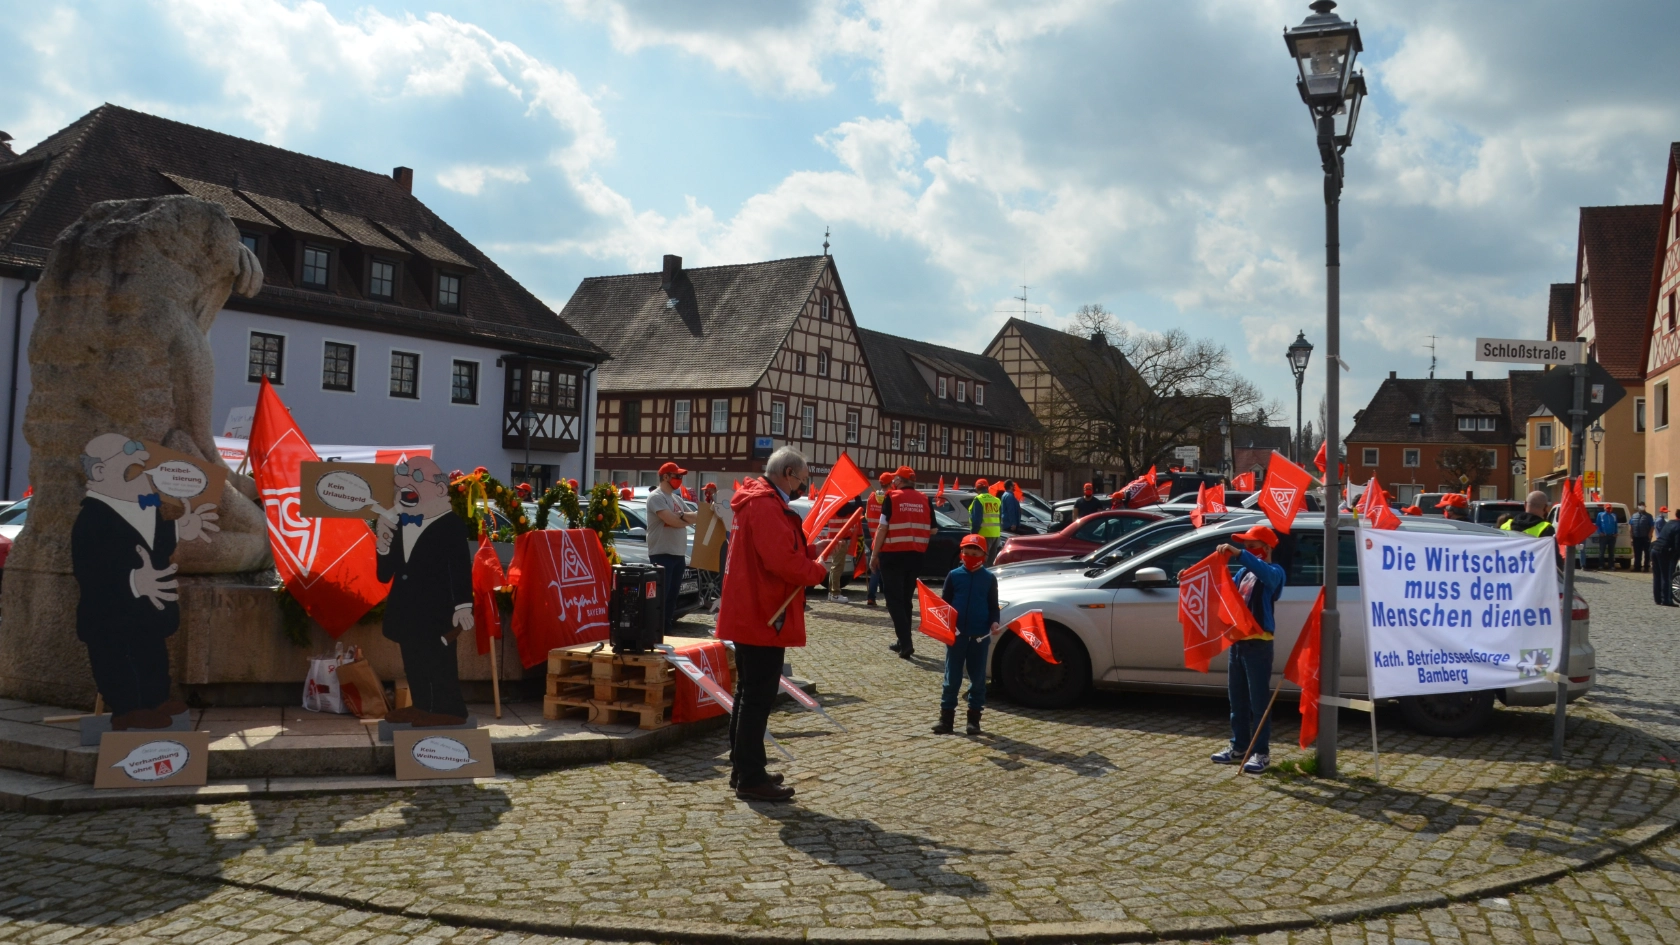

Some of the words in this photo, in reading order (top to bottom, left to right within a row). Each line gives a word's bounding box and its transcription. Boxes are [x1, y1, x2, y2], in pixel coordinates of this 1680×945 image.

[1483, 342, 1566, 360] Schloßstraße
[172, 475, 202, 484] isierung
[327, 482, 345, 490] Kein
[322, 489, 367, 503] Urlaubsgeld
[1382, 545, 1416, 571] Die
[1425, 546, 1536, 574] Wirtschaft
[1404, 580, 1460, 600] muss
[1470, 576, 1513, 600] dem
[586, 607, 606, 617] BAYERN
[1371, 601, 1472, 628] Menschen
[1481, 604, 1552, 628] dienen
[1374, 650, 1404, 667] Kath.
[1407, 648, 1510, 667] Betriebsseelsorge
[1418, 667, 1469, 685] Bamberg
[128, 752, 179, 767] Verhandlung
[416, 753, 470, 763] Weihnachtsgeld
[132, 765, 153, 774] ohne
